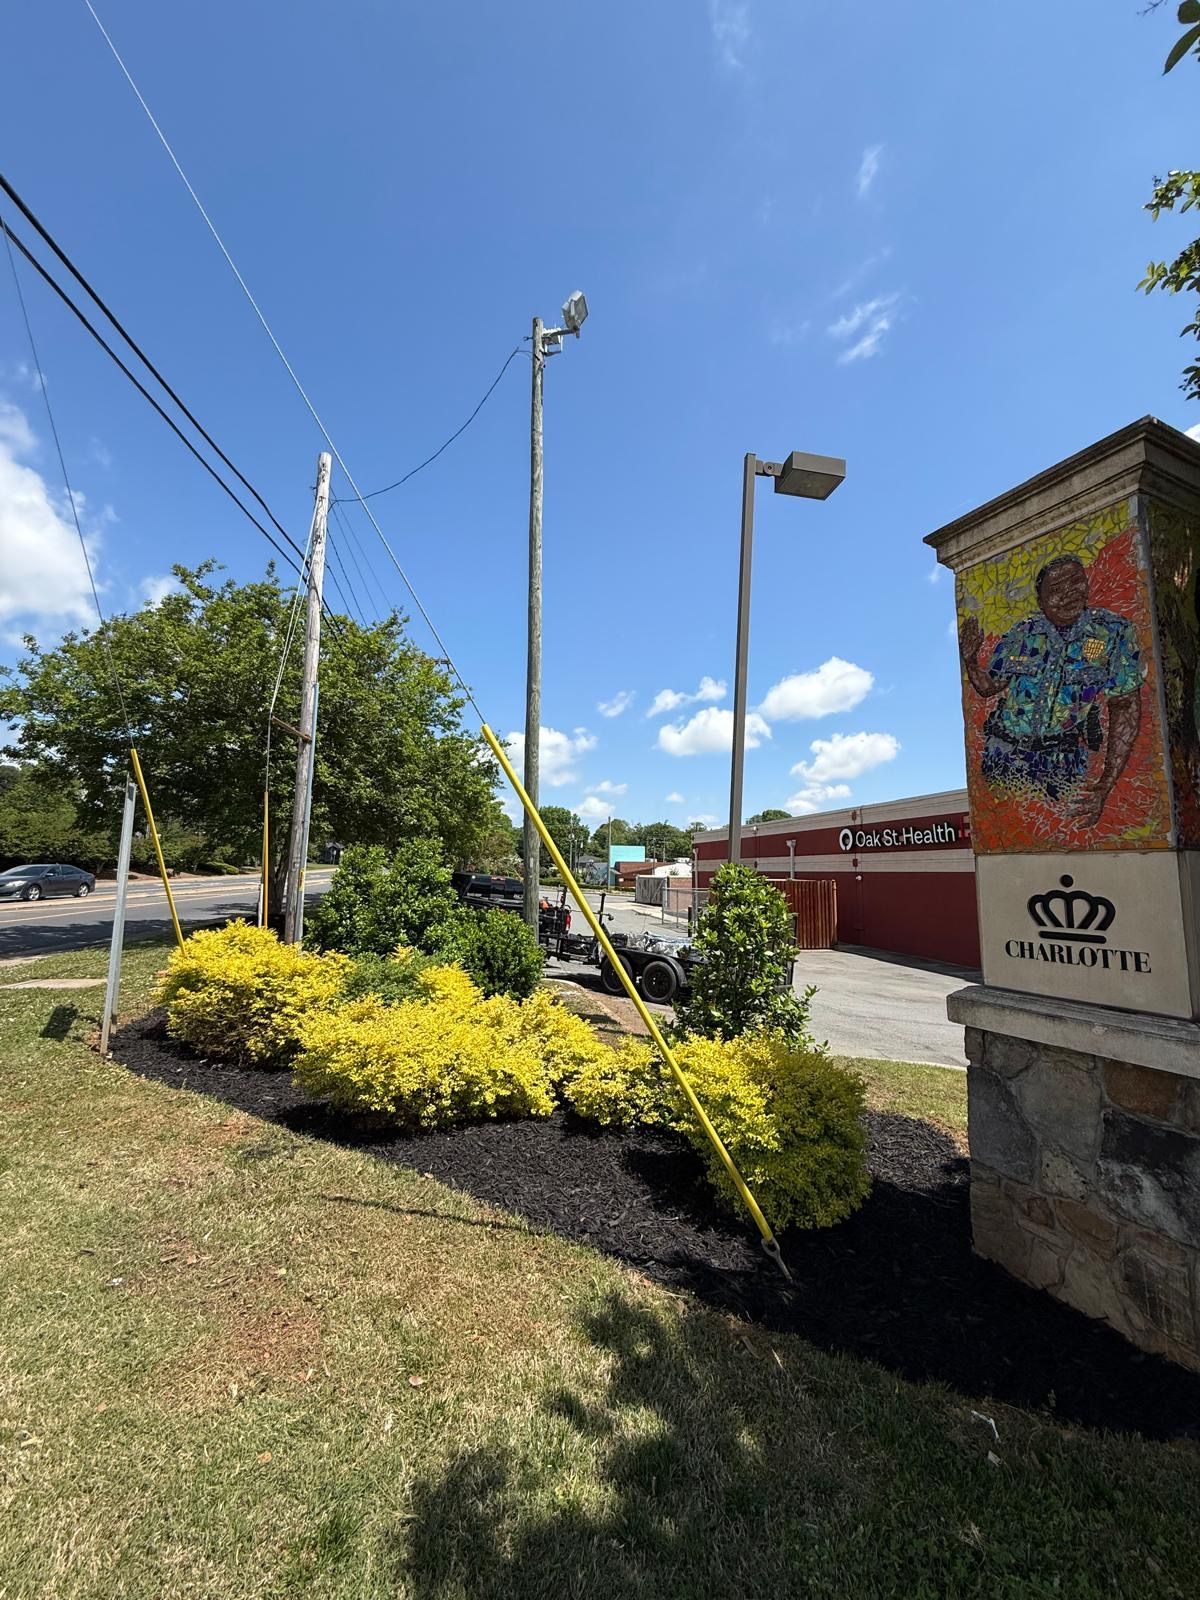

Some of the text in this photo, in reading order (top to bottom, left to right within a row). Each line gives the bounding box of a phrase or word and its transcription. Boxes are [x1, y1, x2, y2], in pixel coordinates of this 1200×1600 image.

[855, 822, 956, 847] Oak St. Health
[1005, 939, 1152, 973] CHARLOTTE
